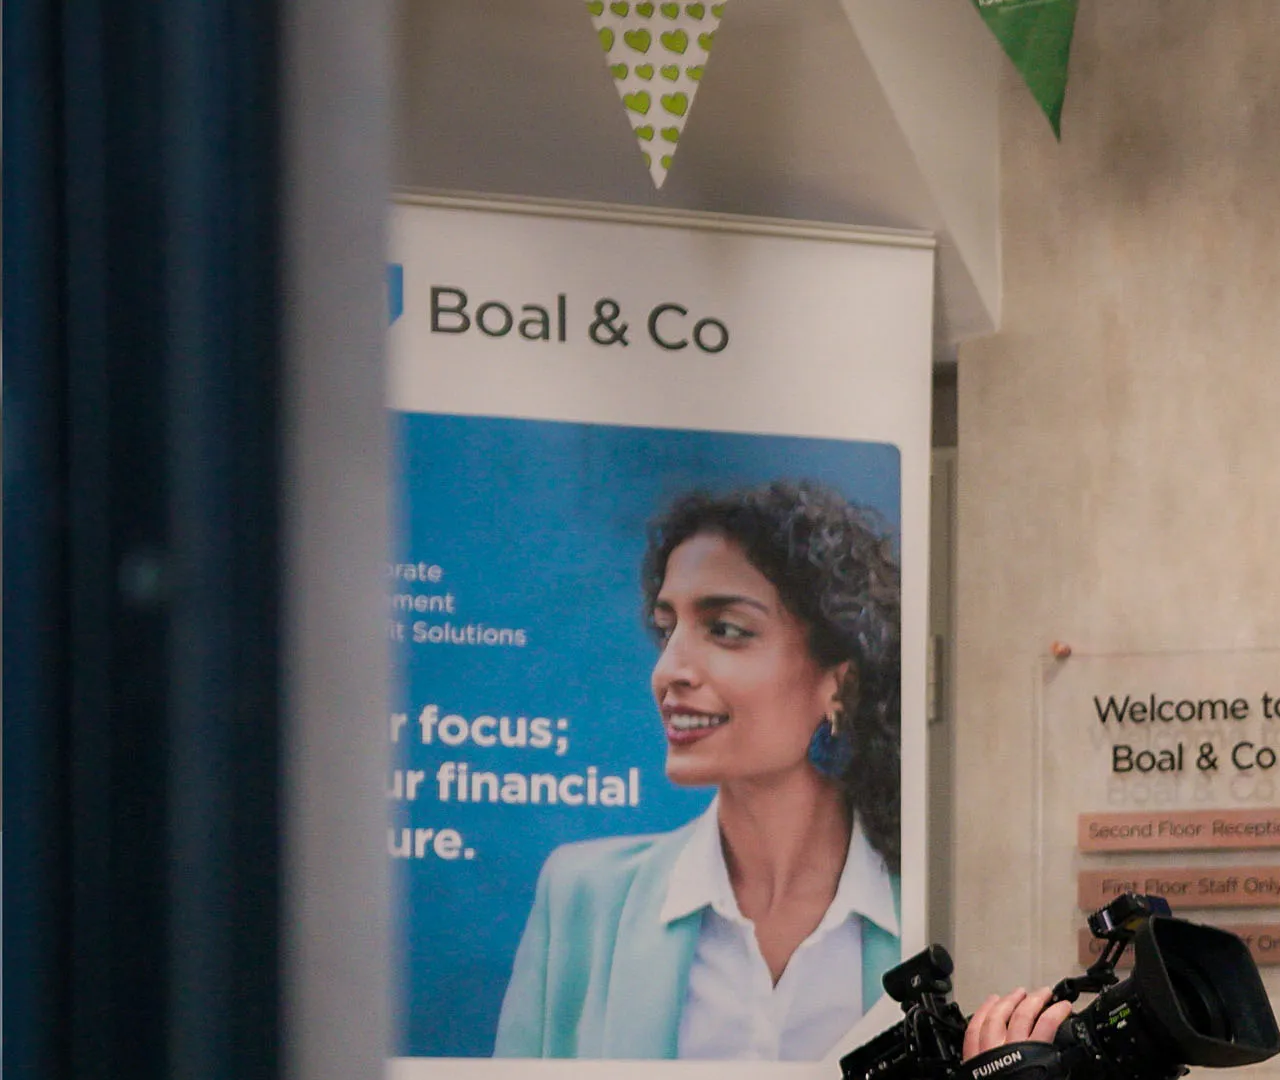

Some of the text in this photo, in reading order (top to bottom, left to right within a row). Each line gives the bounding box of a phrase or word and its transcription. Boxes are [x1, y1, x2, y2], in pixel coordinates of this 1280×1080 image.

[428, 284, 730, 354] Boal & Co
[413, 620, 528, 647] Solutions
[1093, 694, 1249, 724] Welcome
[419, 704, 570, 756] focus;
[1112, 741, 1277, 773] Boal & Co
[437, 762, 641, 807] financial
[1088, 822, 1152, 839] Second
[1101, 878, 1138, 895] First
[1199, 877, 1238, 894] Staff
[972, 1050, 1022, 1080] FUJINON
